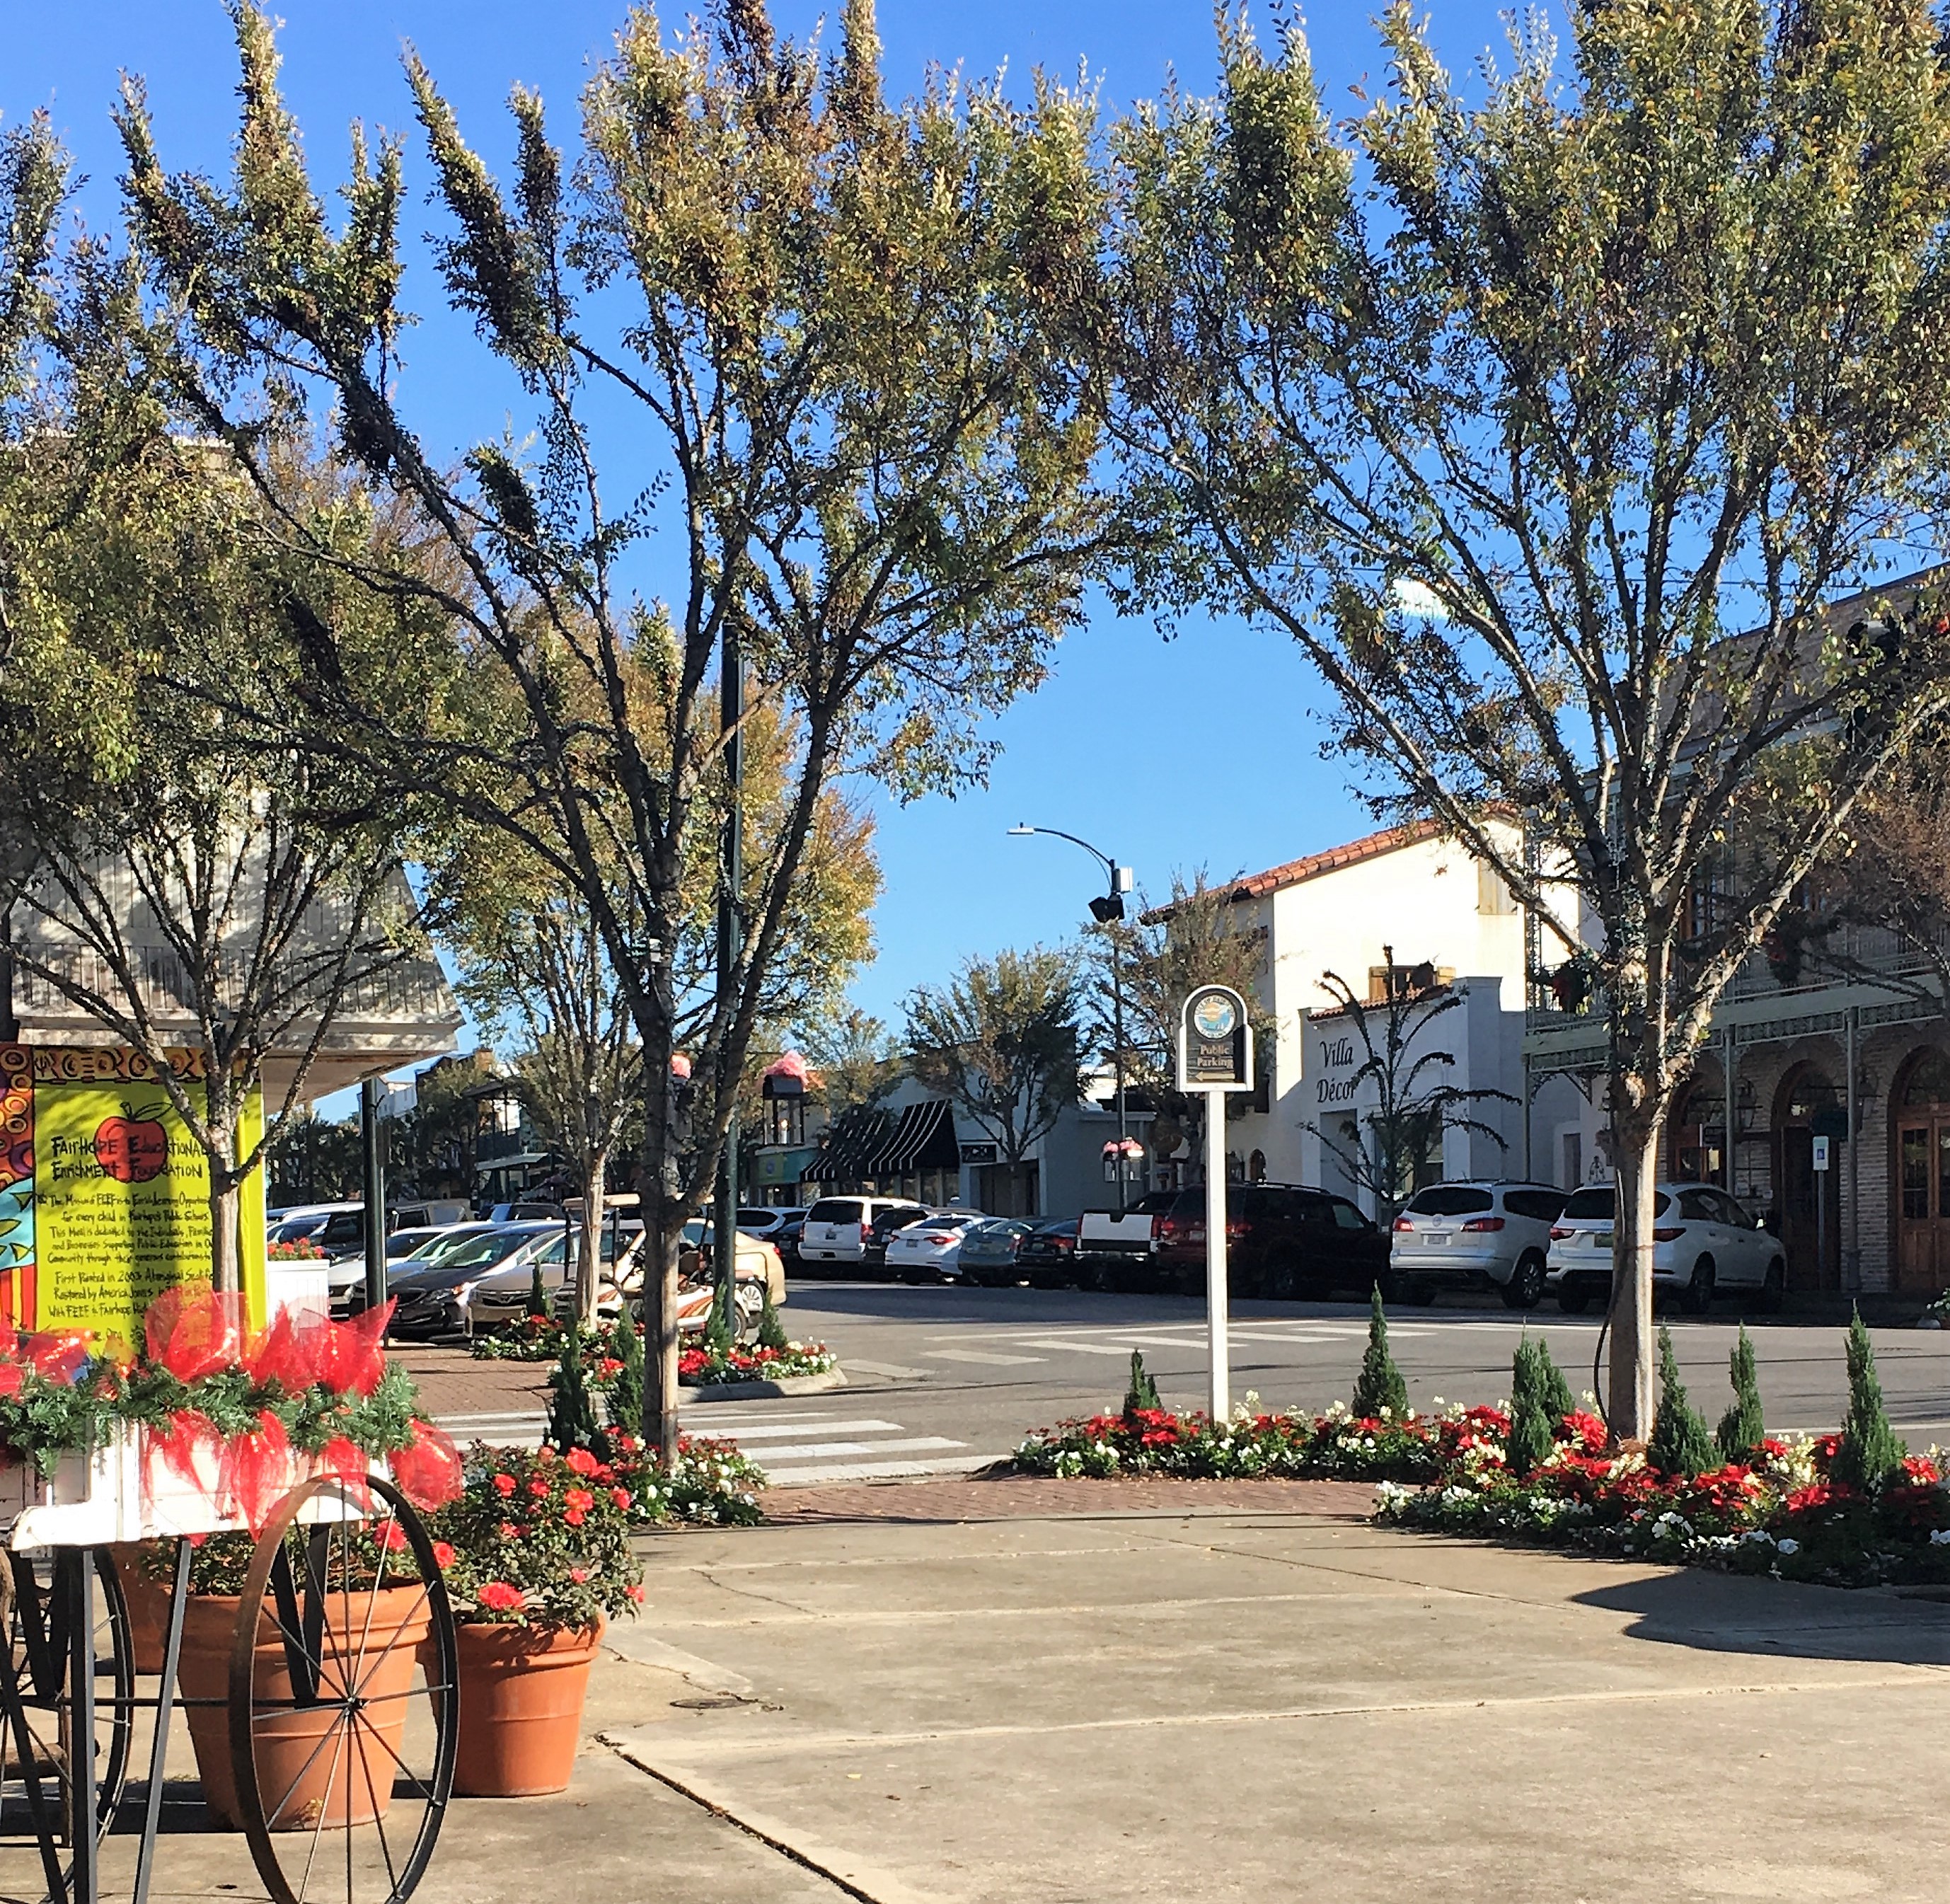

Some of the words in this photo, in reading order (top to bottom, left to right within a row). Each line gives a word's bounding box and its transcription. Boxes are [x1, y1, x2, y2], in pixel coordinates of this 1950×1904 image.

[1200, 1044, 1230, 1055] Public
[1320, 1037, 1354, 1068] Villa
[1197, 1056, 1234, 1069] Parking
[1317, 1078, 1354, 1103] Décor
[75, 1213, 95, 1225] every
[97, 1209, 116, 1222] child
[119, 1213, 127, 1222] in
[49, 1226, 66, 1239] This
[54, 1271, 76, 1285] First
